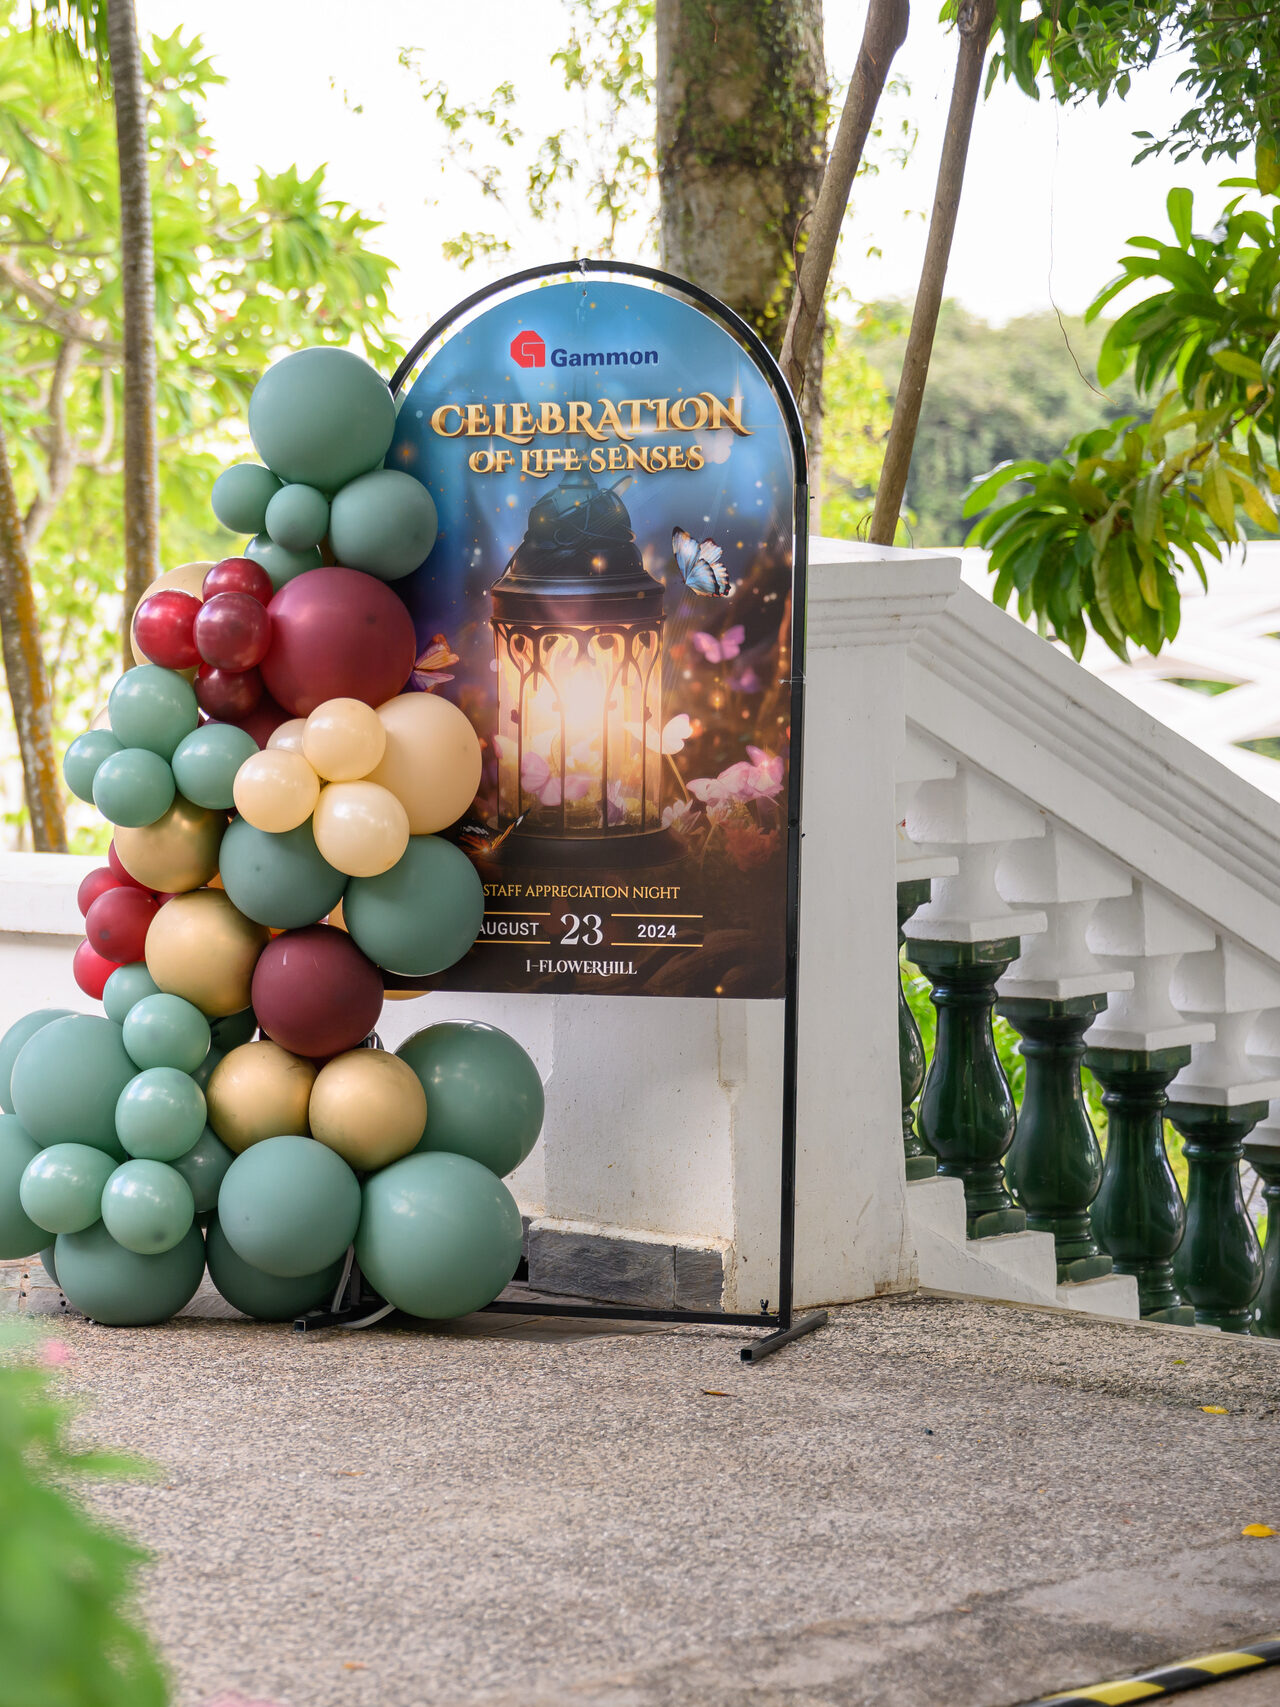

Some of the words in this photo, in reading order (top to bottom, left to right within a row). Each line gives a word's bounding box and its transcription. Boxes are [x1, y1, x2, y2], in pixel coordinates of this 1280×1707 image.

[550, 348, 659, 368] Gammon
[430, 391, 756, 444] CELEBRATION
[469, 449, 515, 474] OF
[521, 448, 582, 478] LIFE
[589, 443, 706, 475] SENSES
[483, 884, 522, 897] STAFF
[525, 885, 629, 899] APPRECIATION
[632, 886, 681, 900] NIGHT
[560, 913, 604, 946] 23
[637, 924, 677, 939] 2024
